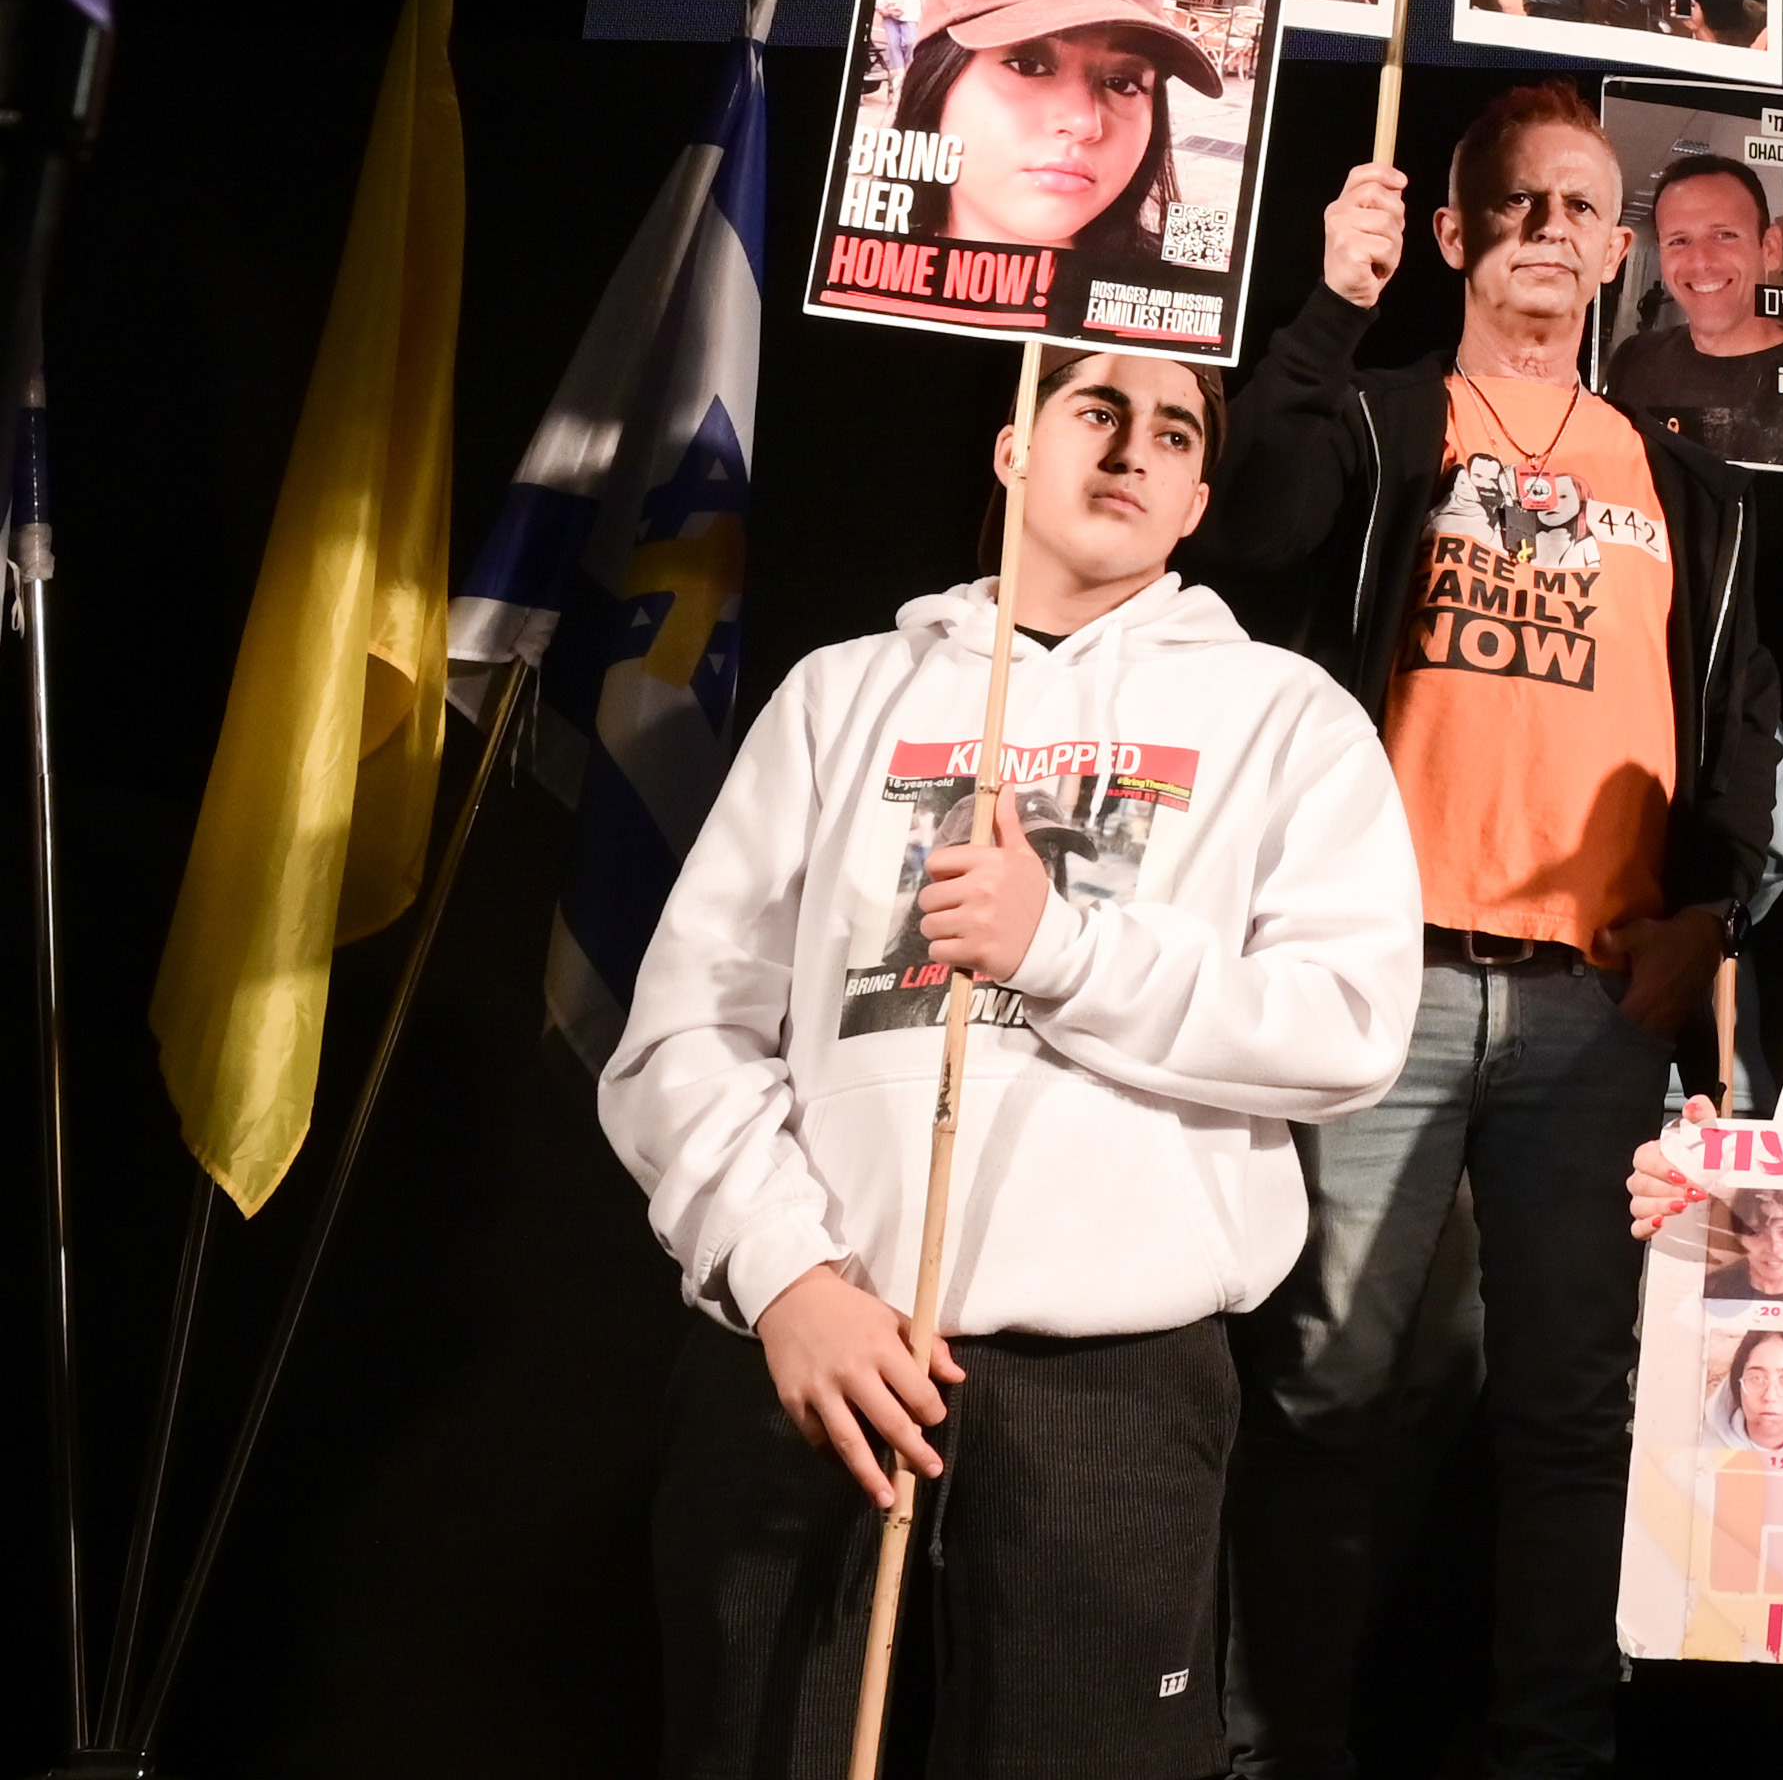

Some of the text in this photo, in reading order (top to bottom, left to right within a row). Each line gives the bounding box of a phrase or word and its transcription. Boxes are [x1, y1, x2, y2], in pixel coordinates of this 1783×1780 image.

[849, 130, 963, 185] BRING
[838, 179, 914, 234] HER
[829, 236, 1054, 307] HOME NOW!
[1434, 537, 1600, 599] REE MY
[1427, 569, 1598, 631] AMILY
[883, 791, 918, 801] Israeli
[845, 973, 896, 996] BRING
